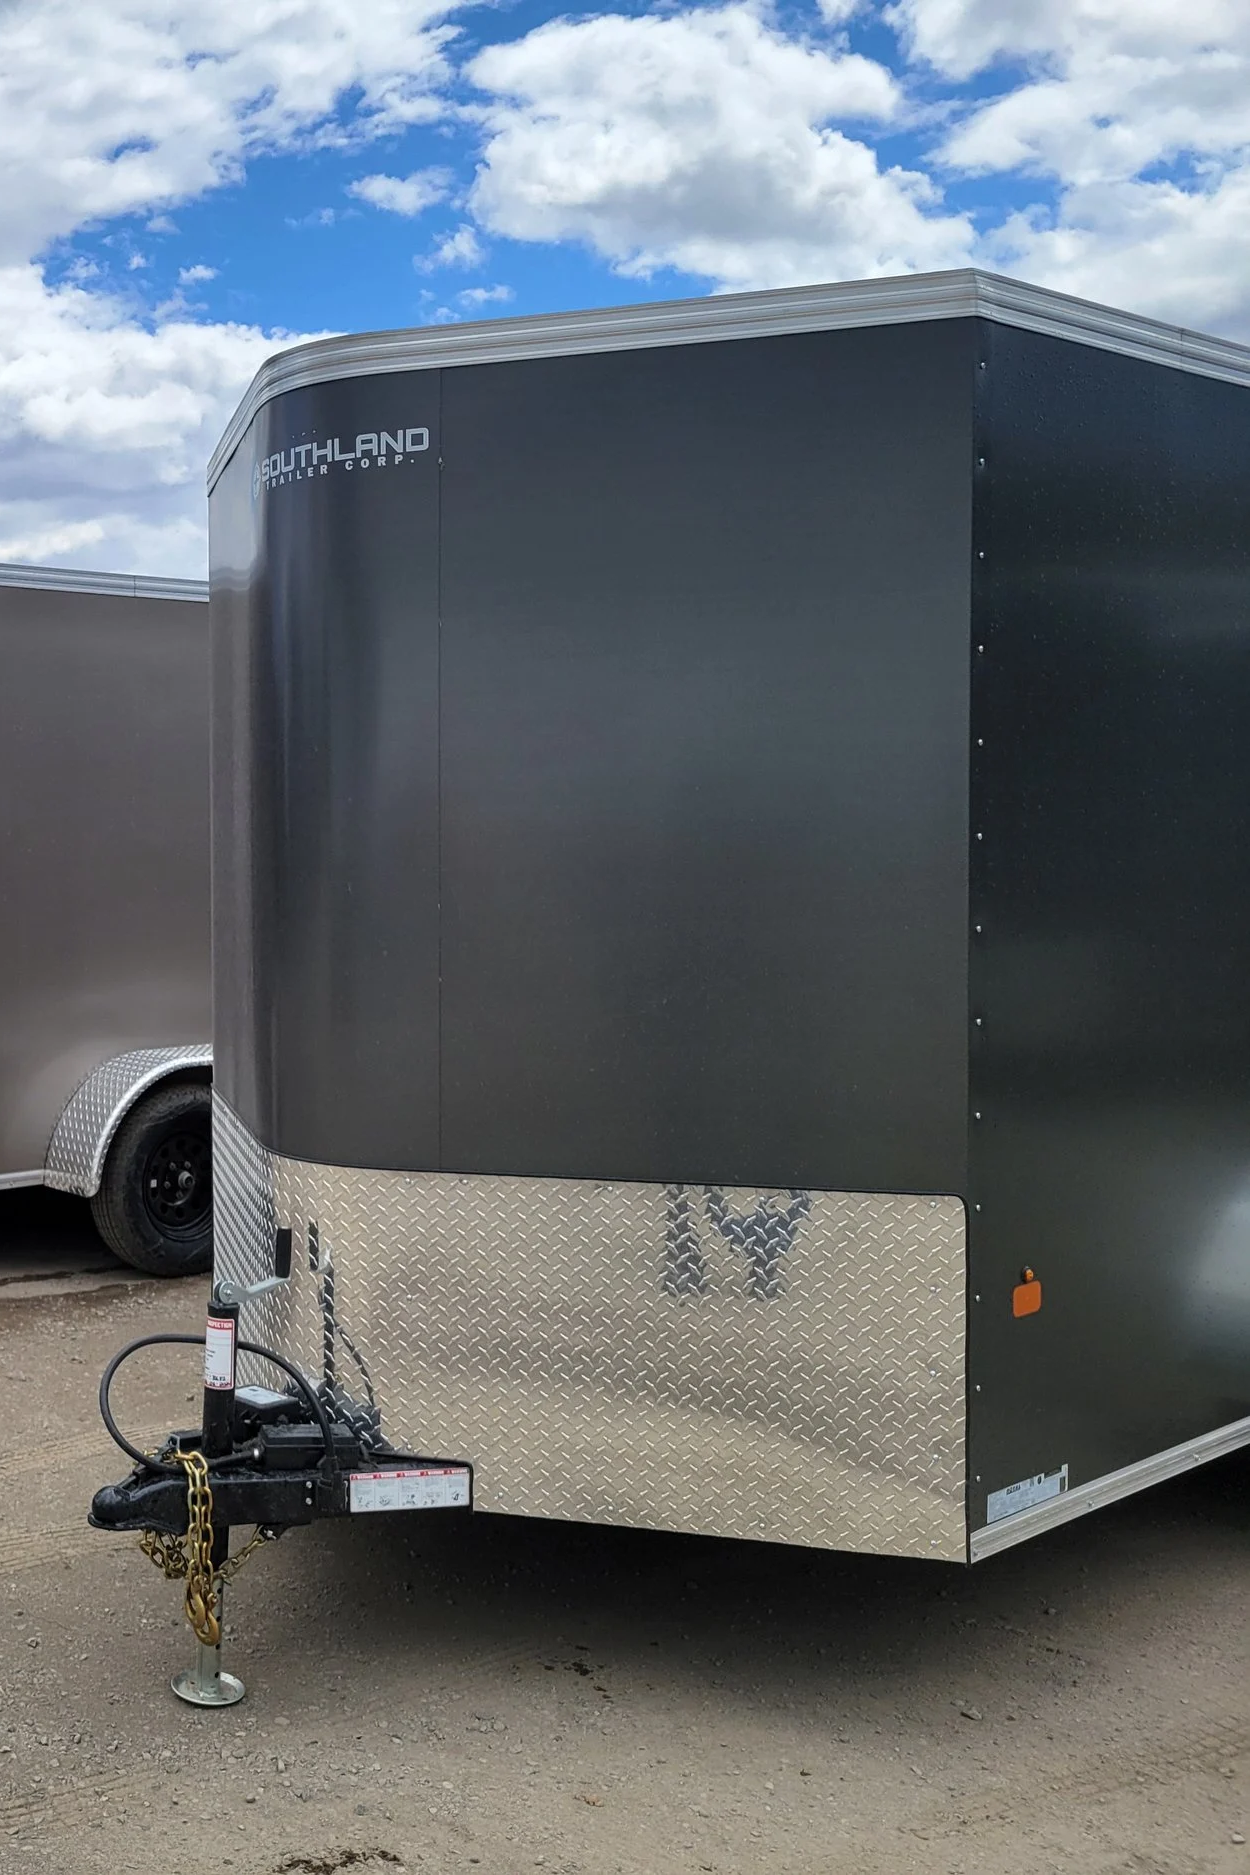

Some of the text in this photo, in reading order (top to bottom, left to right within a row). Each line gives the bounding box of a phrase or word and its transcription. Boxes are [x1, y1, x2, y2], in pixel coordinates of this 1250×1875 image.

[261, 427, 430, 482] SOUTHLAND
[266, 454, 415, 490] TRAILER CORP.
